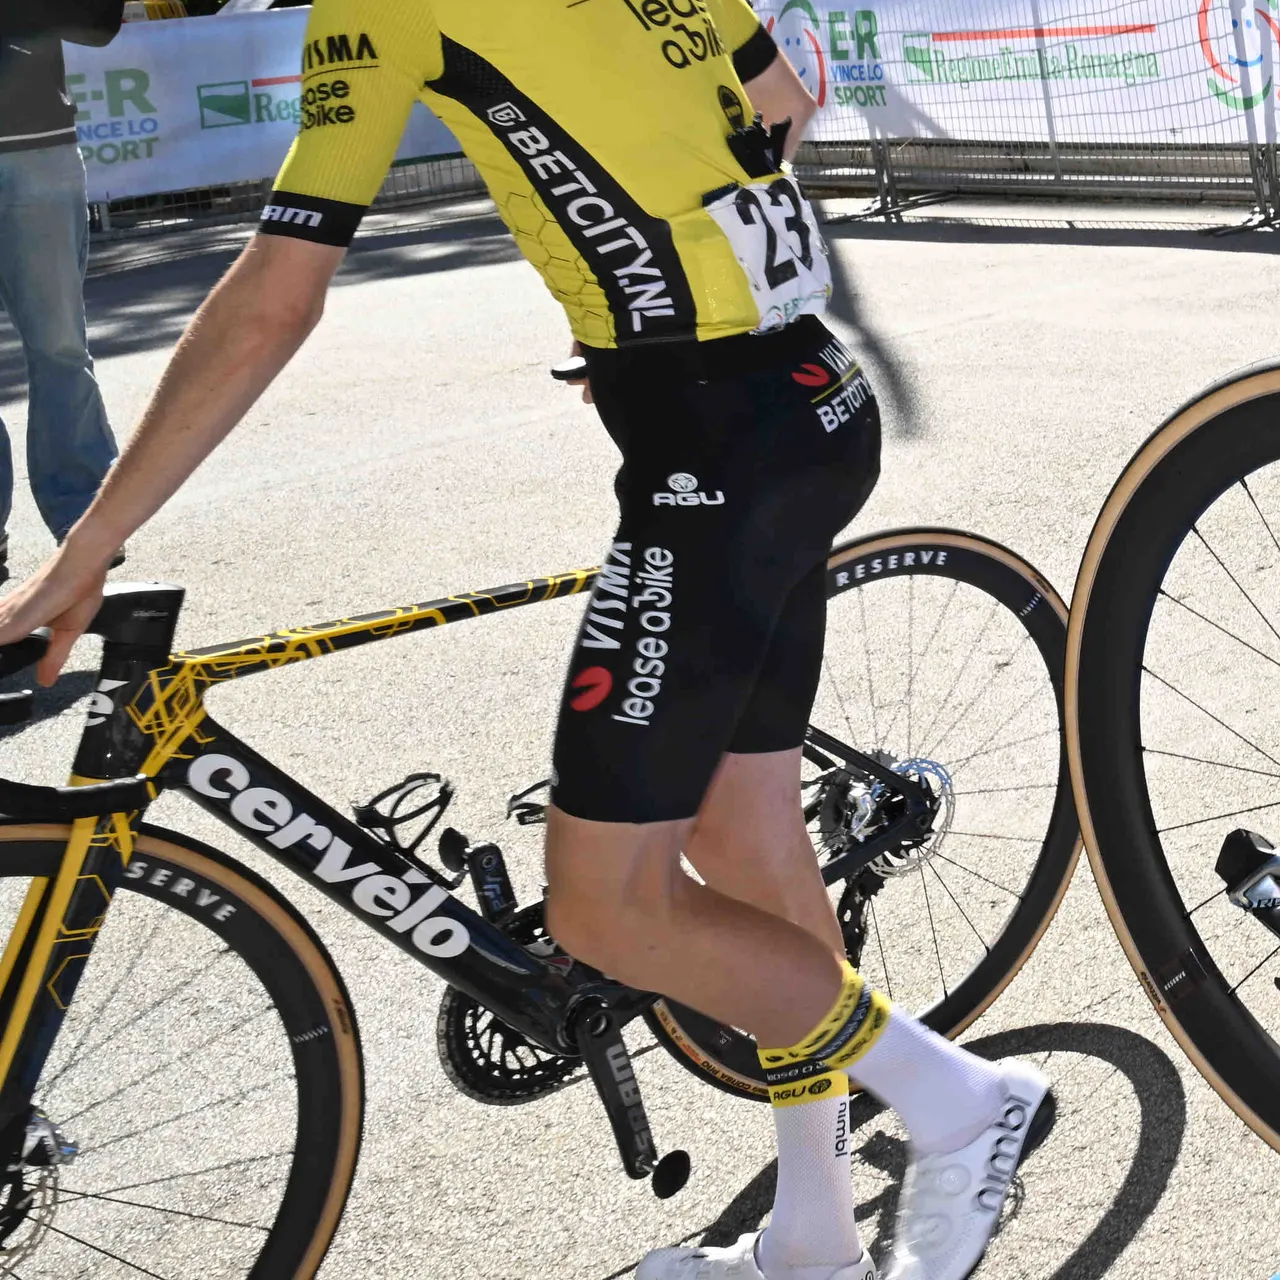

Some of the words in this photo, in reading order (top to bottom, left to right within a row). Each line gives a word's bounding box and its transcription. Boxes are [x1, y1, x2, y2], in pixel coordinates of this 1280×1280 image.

[831, 65, 866, 82] VINCE
[868, 64, 883, 80] LO
[834, 86, 887, 108] SPORT
[80, 137, 159, 163] PORT
[129, 118, 158, 136] LO
[508, 126, 675, 332] BETCITY.NL
[735, 177, 815, 290] 23
[652, 489, 726, 506] AGU
[836, 551, 947, 587] RESERVE
[582, 542, 633, 650] VISMA
[612, 637, 669, 725] lease
[186, 752, 471, 958] cervélo
[774, 1084, 805, 1101] AGU
[835, 1102, 847, 1158] nimbl
[975, 1094, 1032, 1212] nimbl
